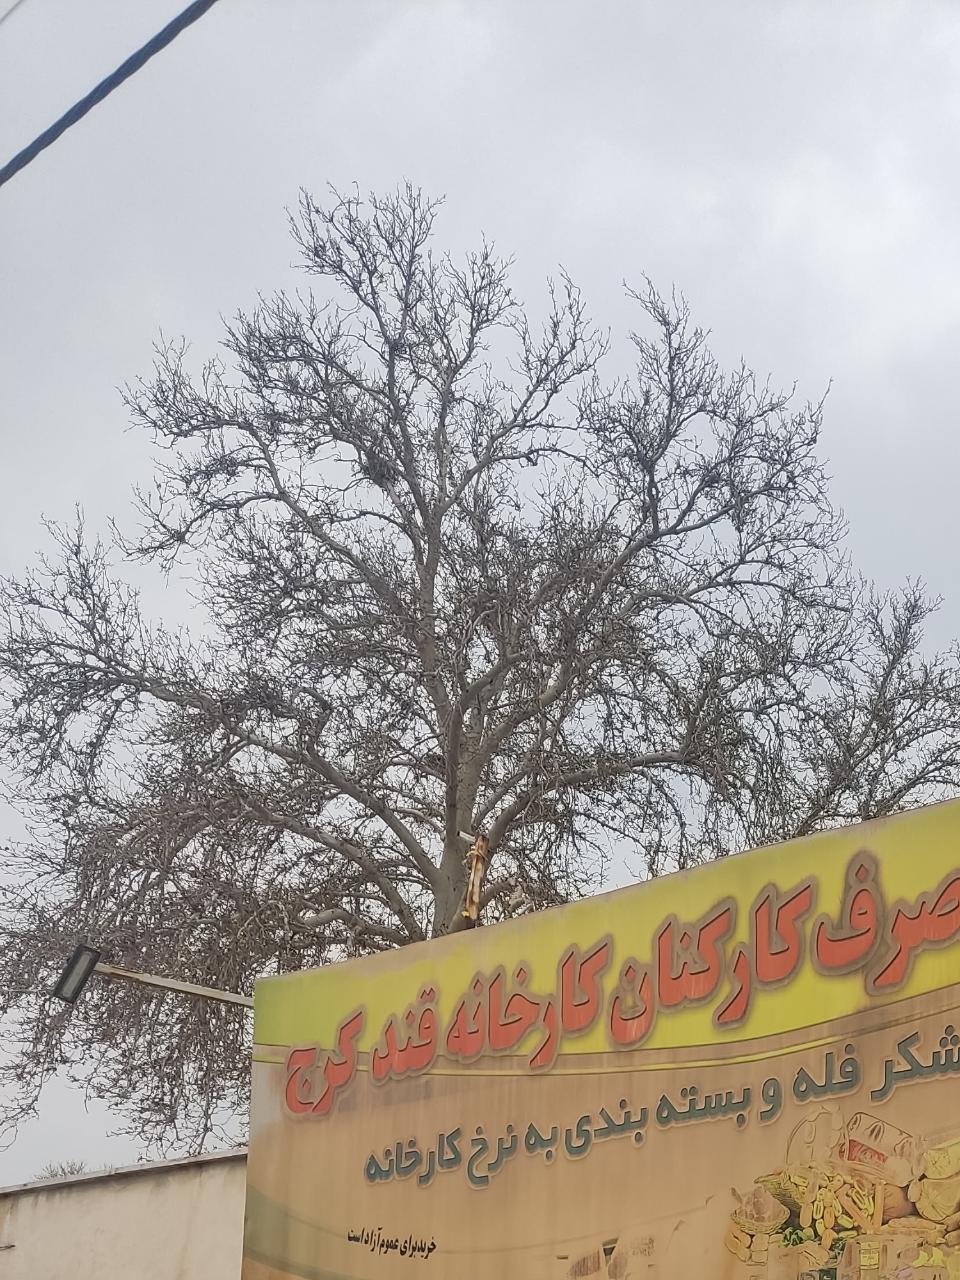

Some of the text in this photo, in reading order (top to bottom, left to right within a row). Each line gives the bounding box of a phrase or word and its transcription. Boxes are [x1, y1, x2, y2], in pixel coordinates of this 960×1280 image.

[611, 882, 813, 1046] کارکنان
[371, 986, 439, 1080] قند
[446, 941, 609, 1068] کارخانه
[285, 1011, 364, 1114] کرج
[792, 1042, 860, 1099] فله
[655, 1084, 751, 1129] بسته
[760, 1077, 782, 1121] و
[364, 1128, 463, 1184] کارخانه
[466, 1124, 517, 1188] نرخ
[524, 1123, 558, 1165] به
[564, 1099, 648, 1157] بندی
[347, 1227, 365, 1242] است
[379, 1237, 399, 1256] عموم
